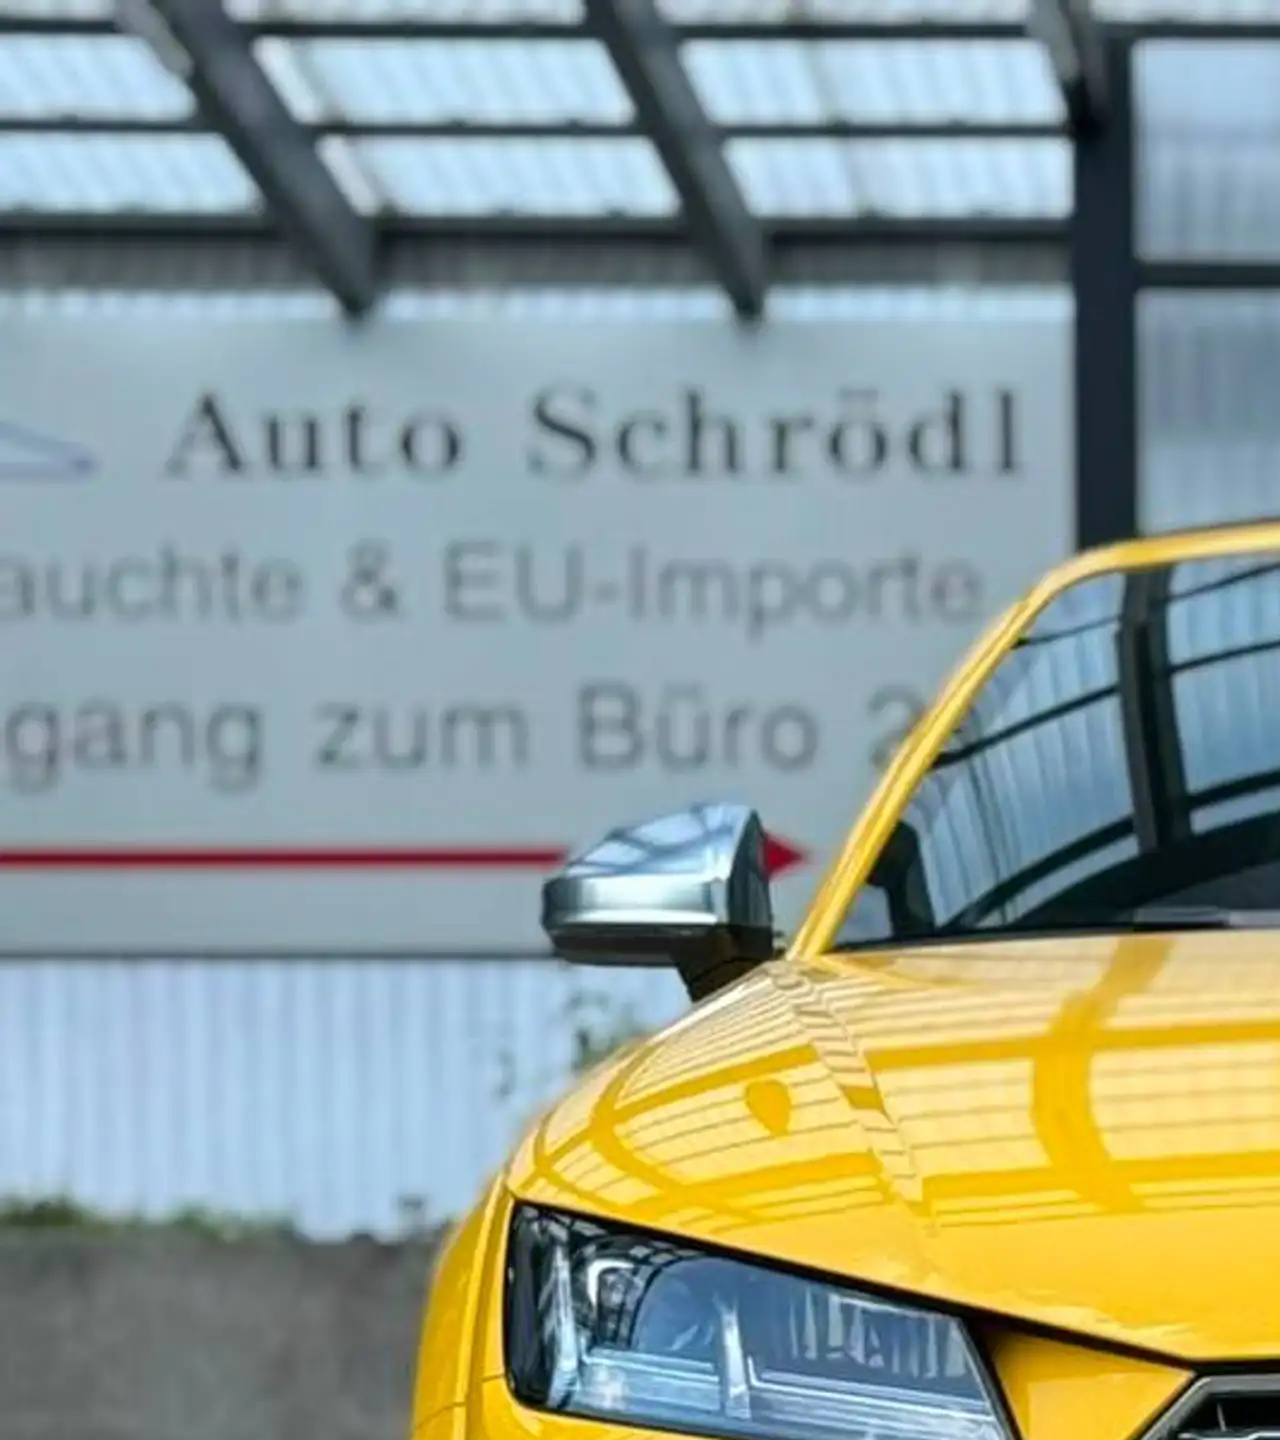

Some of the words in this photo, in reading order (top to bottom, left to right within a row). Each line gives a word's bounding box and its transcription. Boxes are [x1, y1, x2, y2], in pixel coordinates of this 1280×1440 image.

[163, 392, 464, 480] Auto
[526, 384, 1022, 480] Schrödl
[340, 543, 400, 618] &
[443, 540, 984, 645] EU-Importe
[314, 701, 528, 770] zum
[578, 684, 820, 771] Büro
